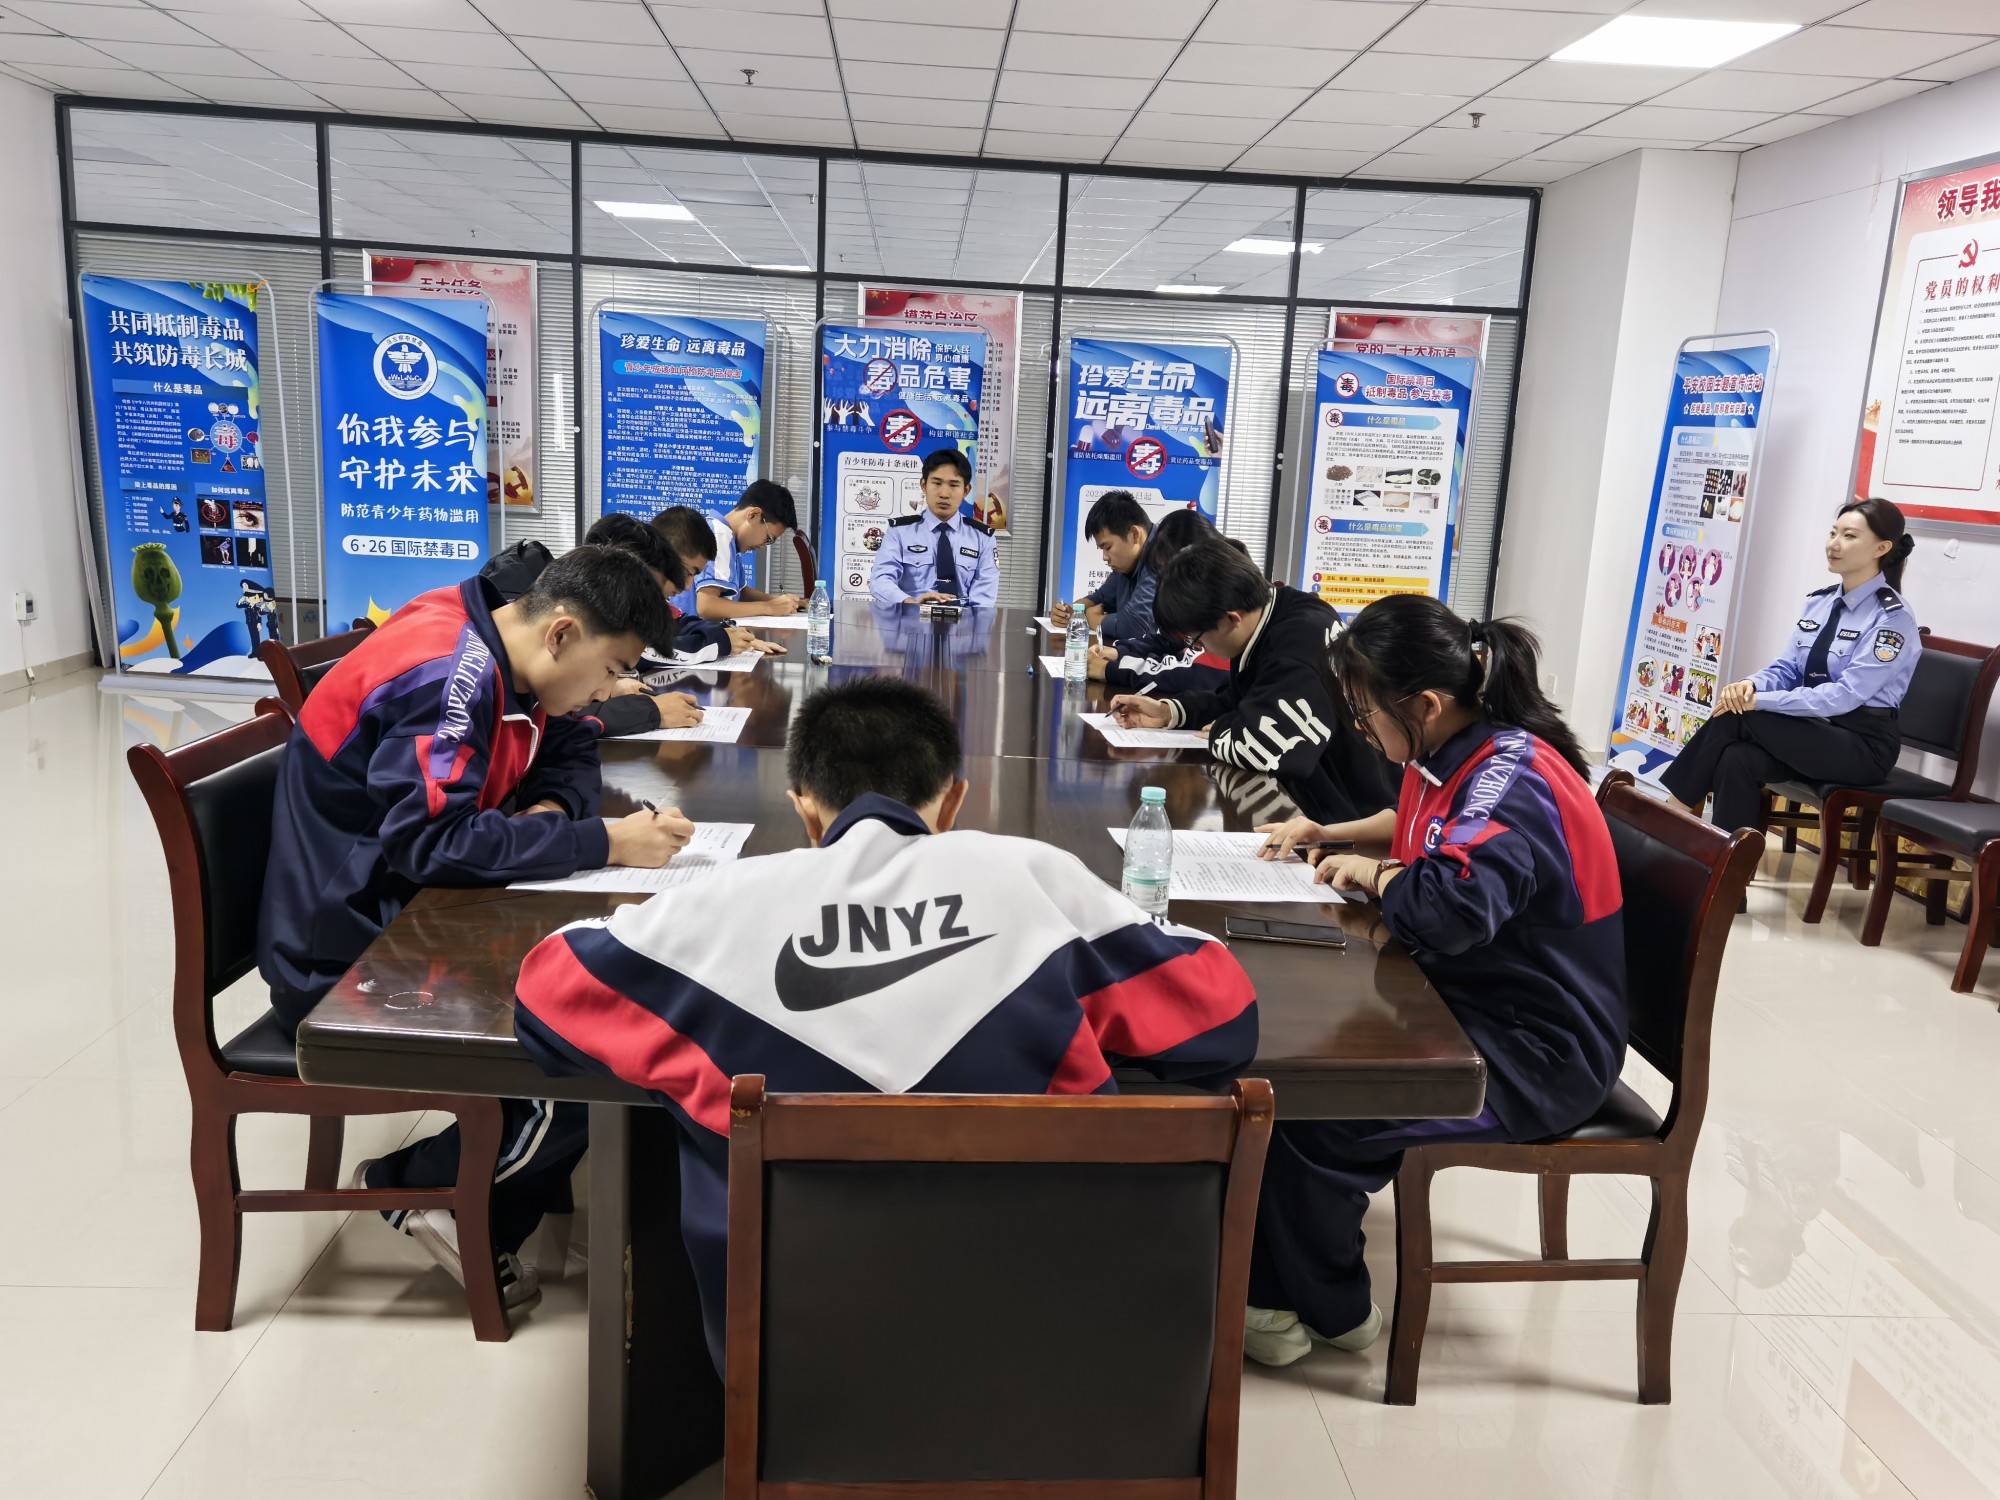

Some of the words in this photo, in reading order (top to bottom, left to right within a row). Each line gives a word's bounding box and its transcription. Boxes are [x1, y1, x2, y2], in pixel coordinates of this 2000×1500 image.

[419, 277, 483, 295] 五大任务
[108, 310, 244, 341] 共同抵制毒品
[904, 309, 978, 327] 模范自治区
[620, 333, 681, 352] 珍爱生命
[686, 339, 746, 357] 远离毒品
[834, 334, 932, 361] 大力消除
[935, 343, 970, 354] 保护人民
[1355, 343, 1457, 357] 党的二十大标语
[111, 341, 248, 372] 共筑防毒长城
[934, 354, 970, 364] 身心健康
[624, 363, 743, 379] 青少年应该如何预防毒品侵害
[866, 363, 971, 391] 毒品危害
[1078, 360, 1196, 392] 珍爱生命
[153, 382, 203, 395] 什么是毒品
[1386, 374, 1435, 387] 国际禁毒日
[1683, 375, 1764, 394] 平安校园主题宣传活动
[1365, 386, 1408, 399] 抵制毒品
[1410, 388, 1453, 402] 参与禁毒
[1075, 390, 1215, 430] 远离毒品
[826, 424, 872, 433] 参与禁毒斗争
[1367, 416, 1406, 426] 什么是毒品
[214, 424, 239, 449] 毒
[336, 413, 478, 451] 你我参与
[885, 415, 917, 447] 毒
[929, 429, 975, 439] 构建和谐社会
[844, 456, 918, 469] 青少年防毒十条戒律
[1073, 451, 1122, 461] 谨防依托咪酯滥用
[1131, 443, 1161, 474] 毒
[338, 455, 478, 495] 守护未来
[134, 481, 177, 491] 染上毒品的原因
[341, 503, 479, 524] 防范青少年药物滥用
[799, 894, 970, 957] JNYZ
